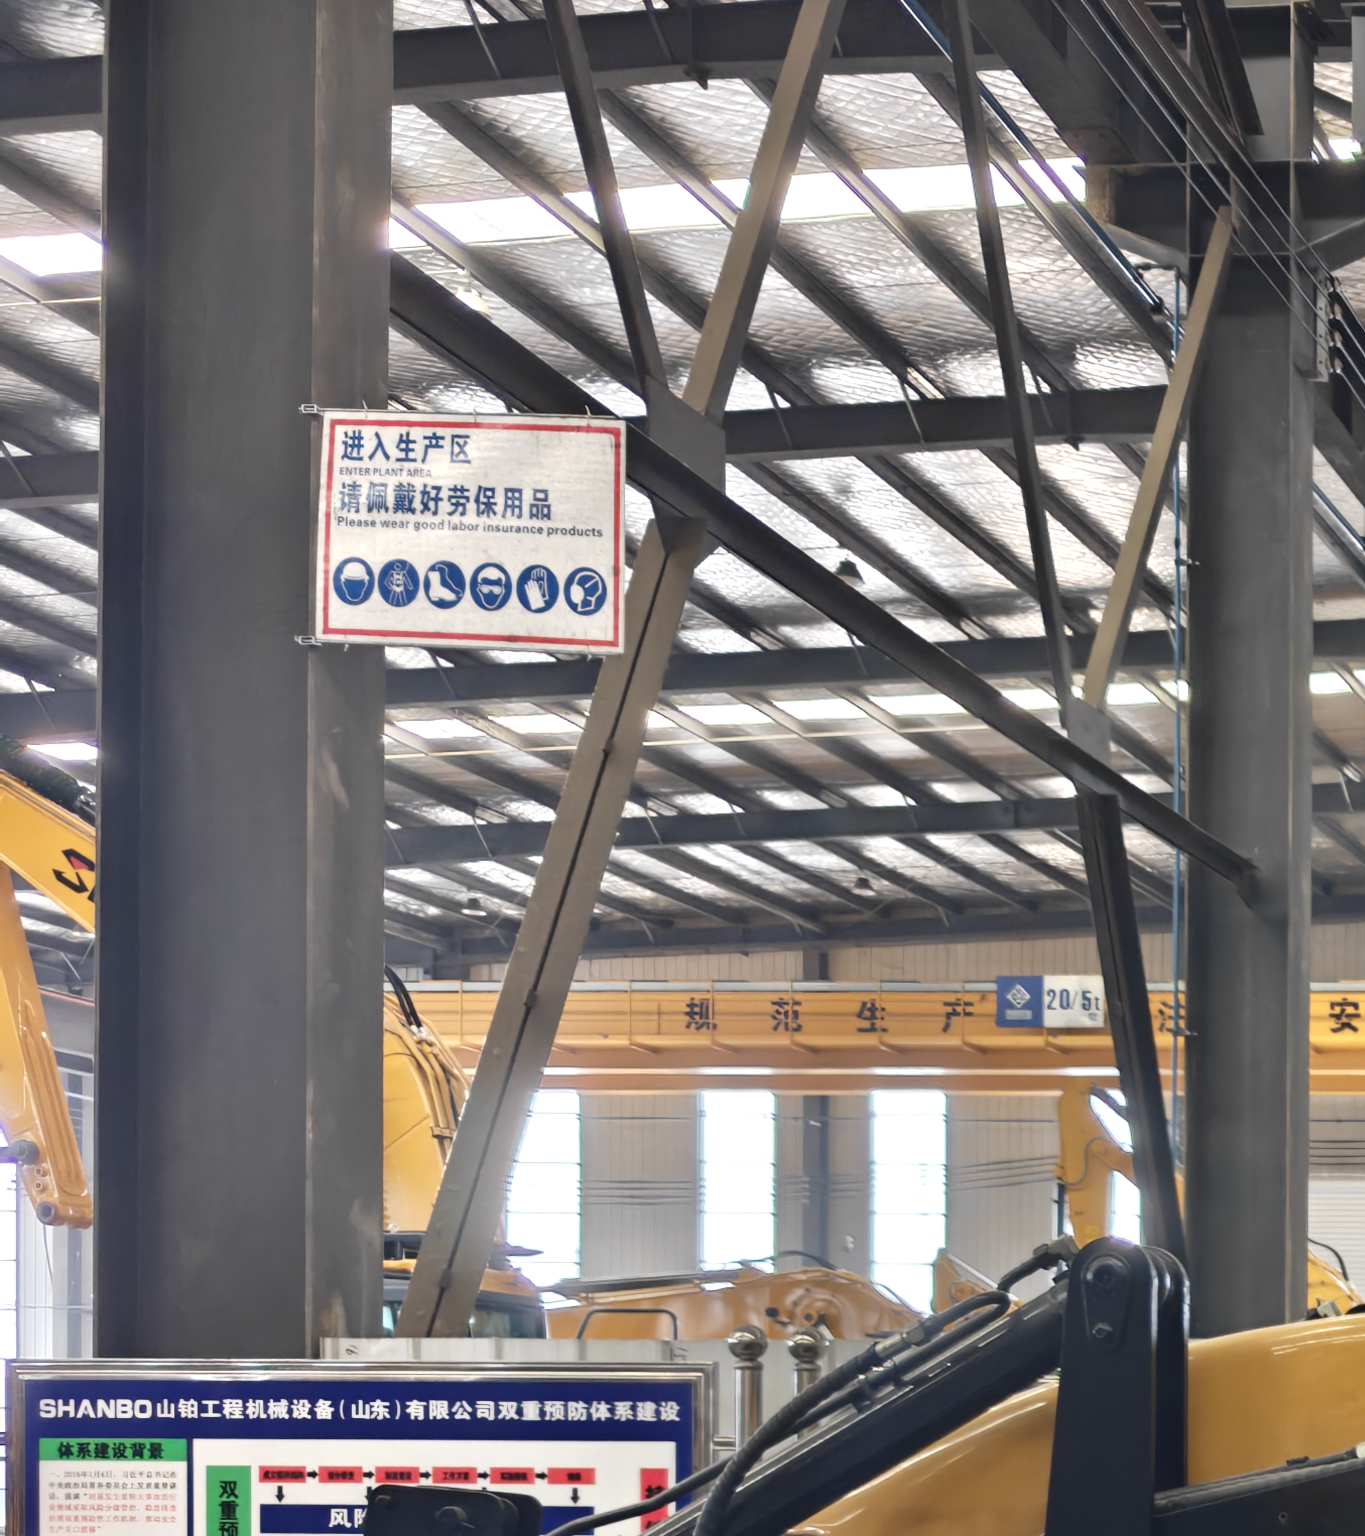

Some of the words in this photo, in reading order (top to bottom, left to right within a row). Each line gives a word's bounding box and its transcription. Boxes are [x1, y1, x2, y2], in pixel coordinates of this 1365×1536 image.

[341, 430, 472, 464] 进入生产区
[339, 467, 371, 477] ENTER
[373, 468, 404, 478] PLANT
[407, 469, 432, 478] AREA
[338, 481, 552, 521] 请佩戴好劳保用品
[337, 516, 377, 528] Please
[380, 520, 409, 529] wear
[413, 520, 445, 532] good
[448, 520, 479, 532] labor
[483, 522, 544, 536] insurance
[547, 525, 603, 539] products
[1046, 988, 1101, 1011] 20/5t
[57, 1441, 165, 1459] 体系建设背景
